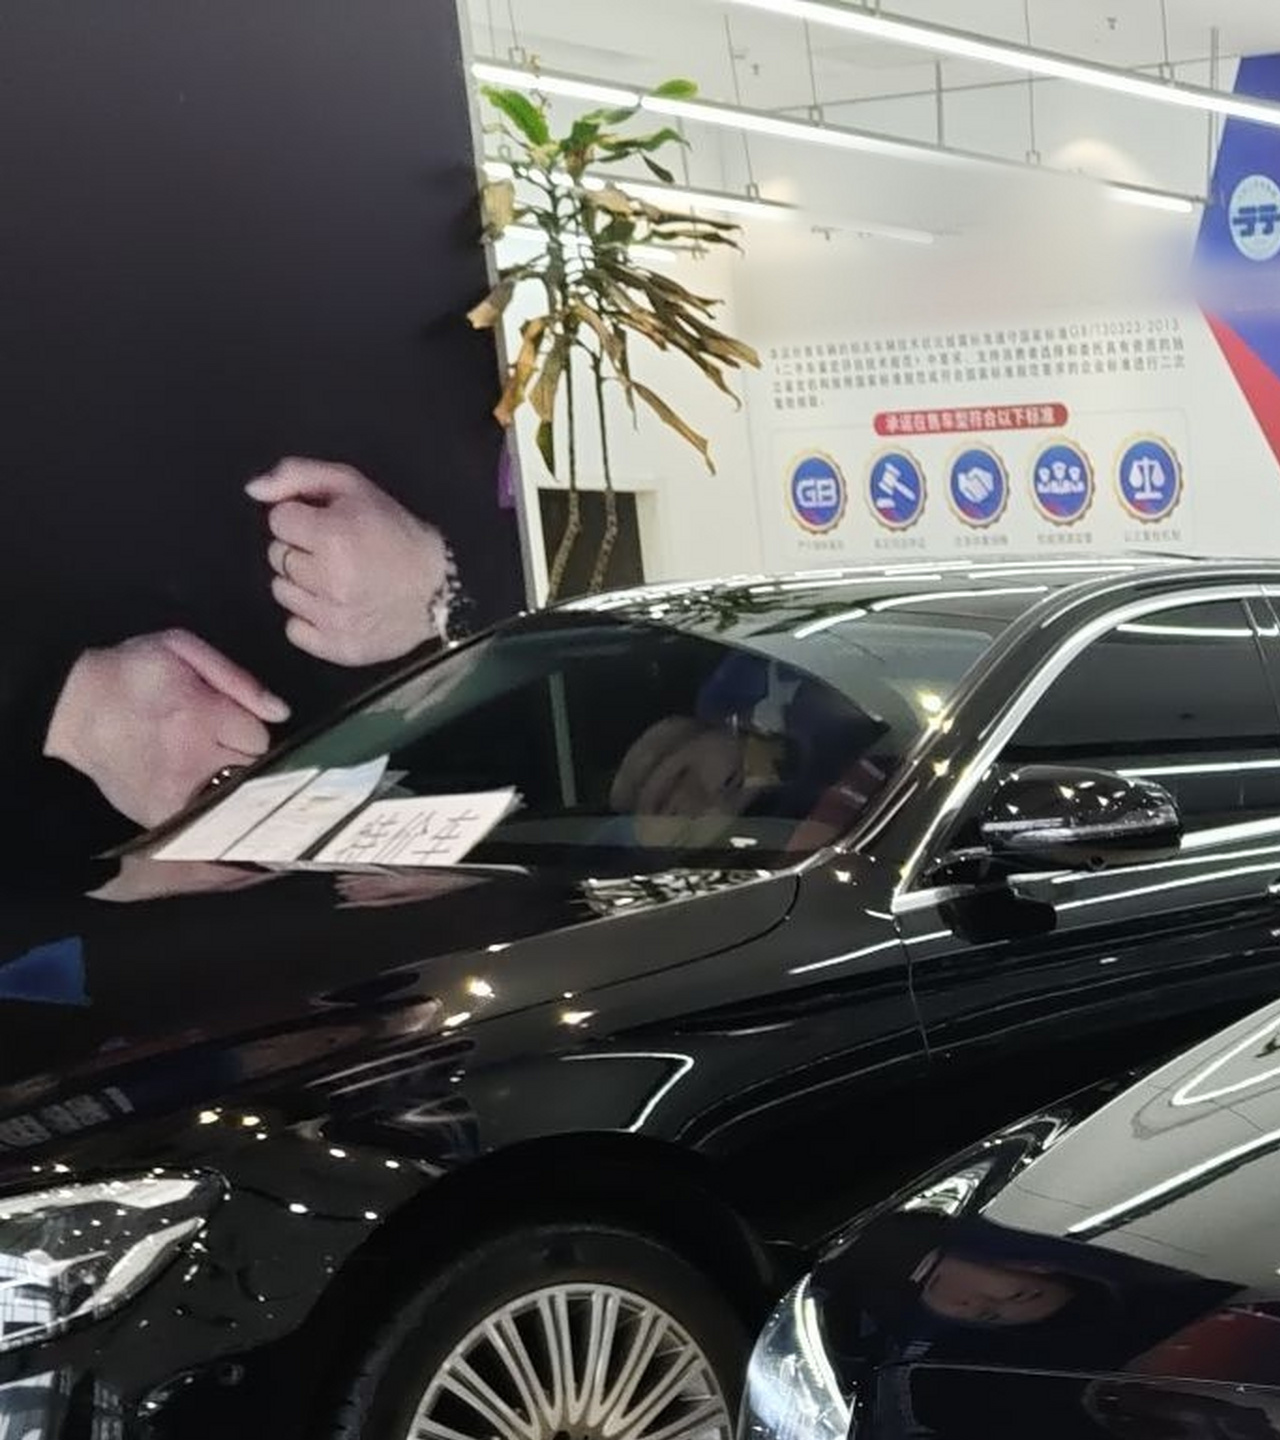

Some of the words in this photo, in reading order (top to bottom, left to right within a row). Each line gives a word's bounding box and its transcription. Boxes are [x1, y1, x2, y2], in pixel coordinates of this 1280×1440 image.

[886, 406, 1055, 432] 承诺在售车型符合以下标准
[797, 478, 837, 508] GB
